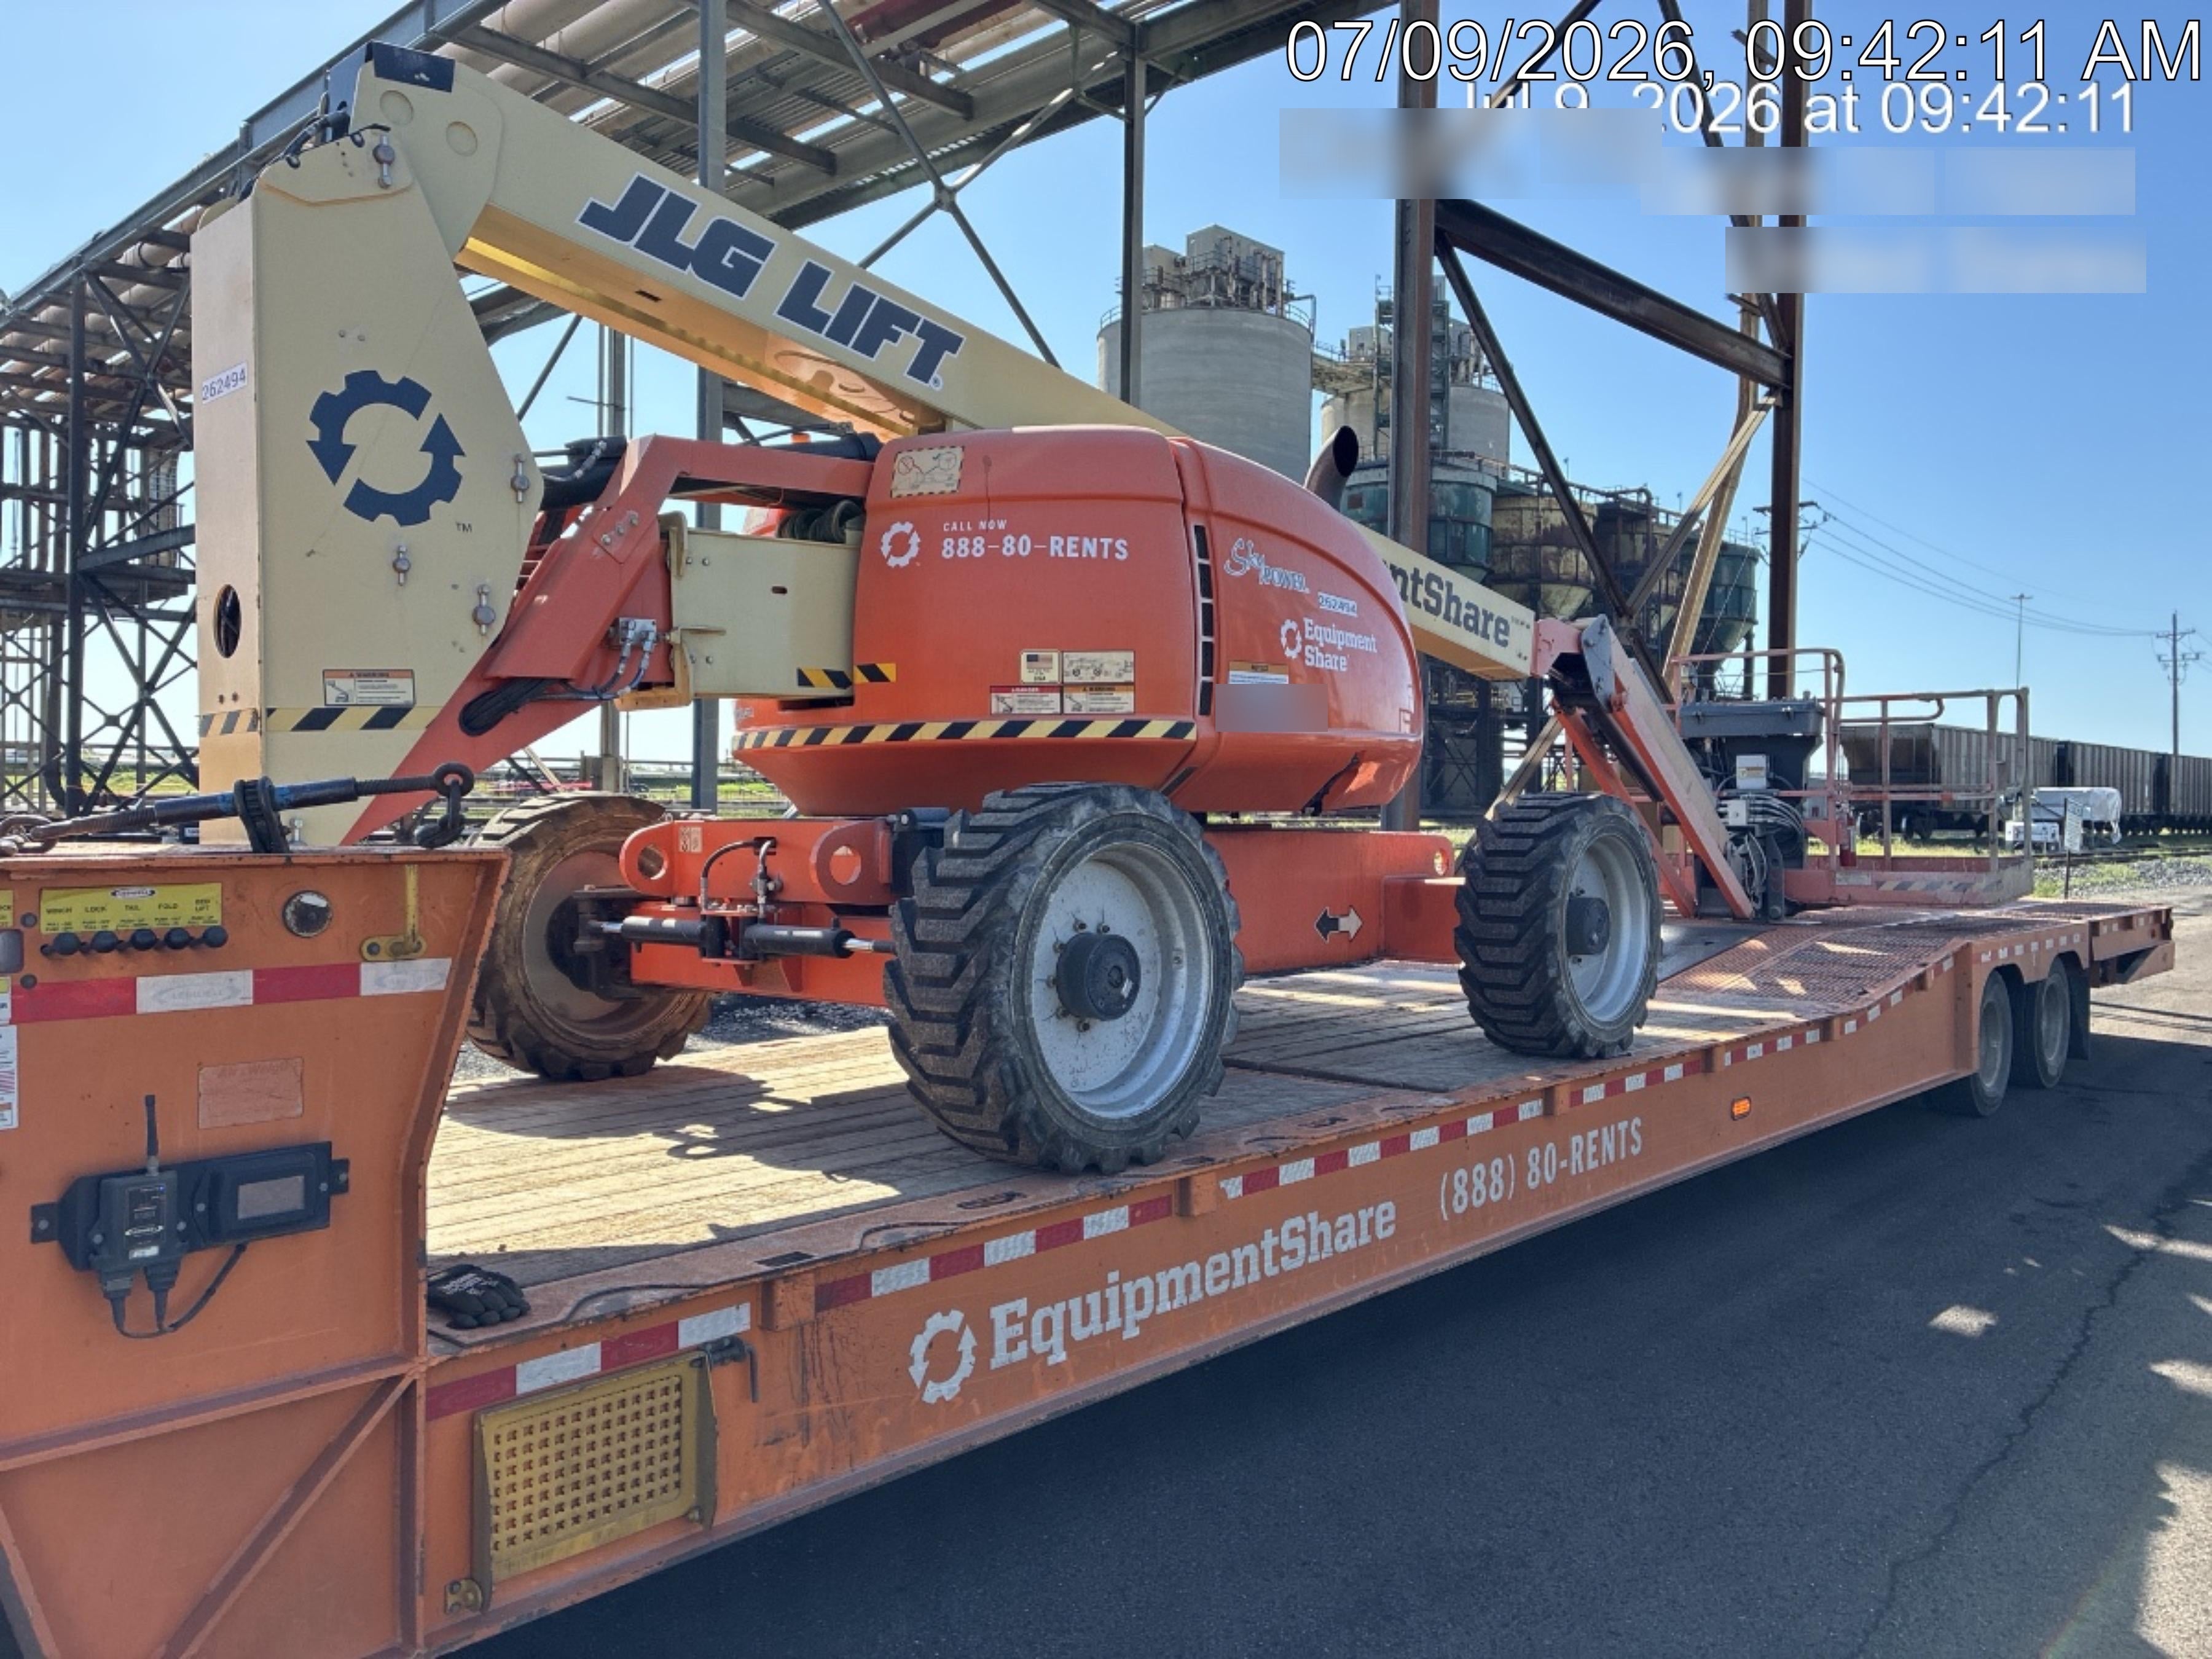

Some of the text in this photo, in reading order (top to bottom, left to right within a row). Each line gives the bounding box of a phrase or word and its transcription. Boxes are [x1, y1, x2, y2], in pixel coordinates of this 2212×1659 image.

[575, 171, 967, 387] JLG LIFT
[202, 369, 246, 399] 262494
[943, 519, 1008, 531] CALL NOW
[941, 533, 1129, 560] 888-80-RENTS
[1389, 560, 1510, 648] ntShare
[1303, 618, 1378, 653] Equipment
[1304, 645, 1347, 672] Share
[1441, 1117, 1642, 1221] (888) 80-RENTS
[990, 1201, 1396, 1370] EquipmentShare
